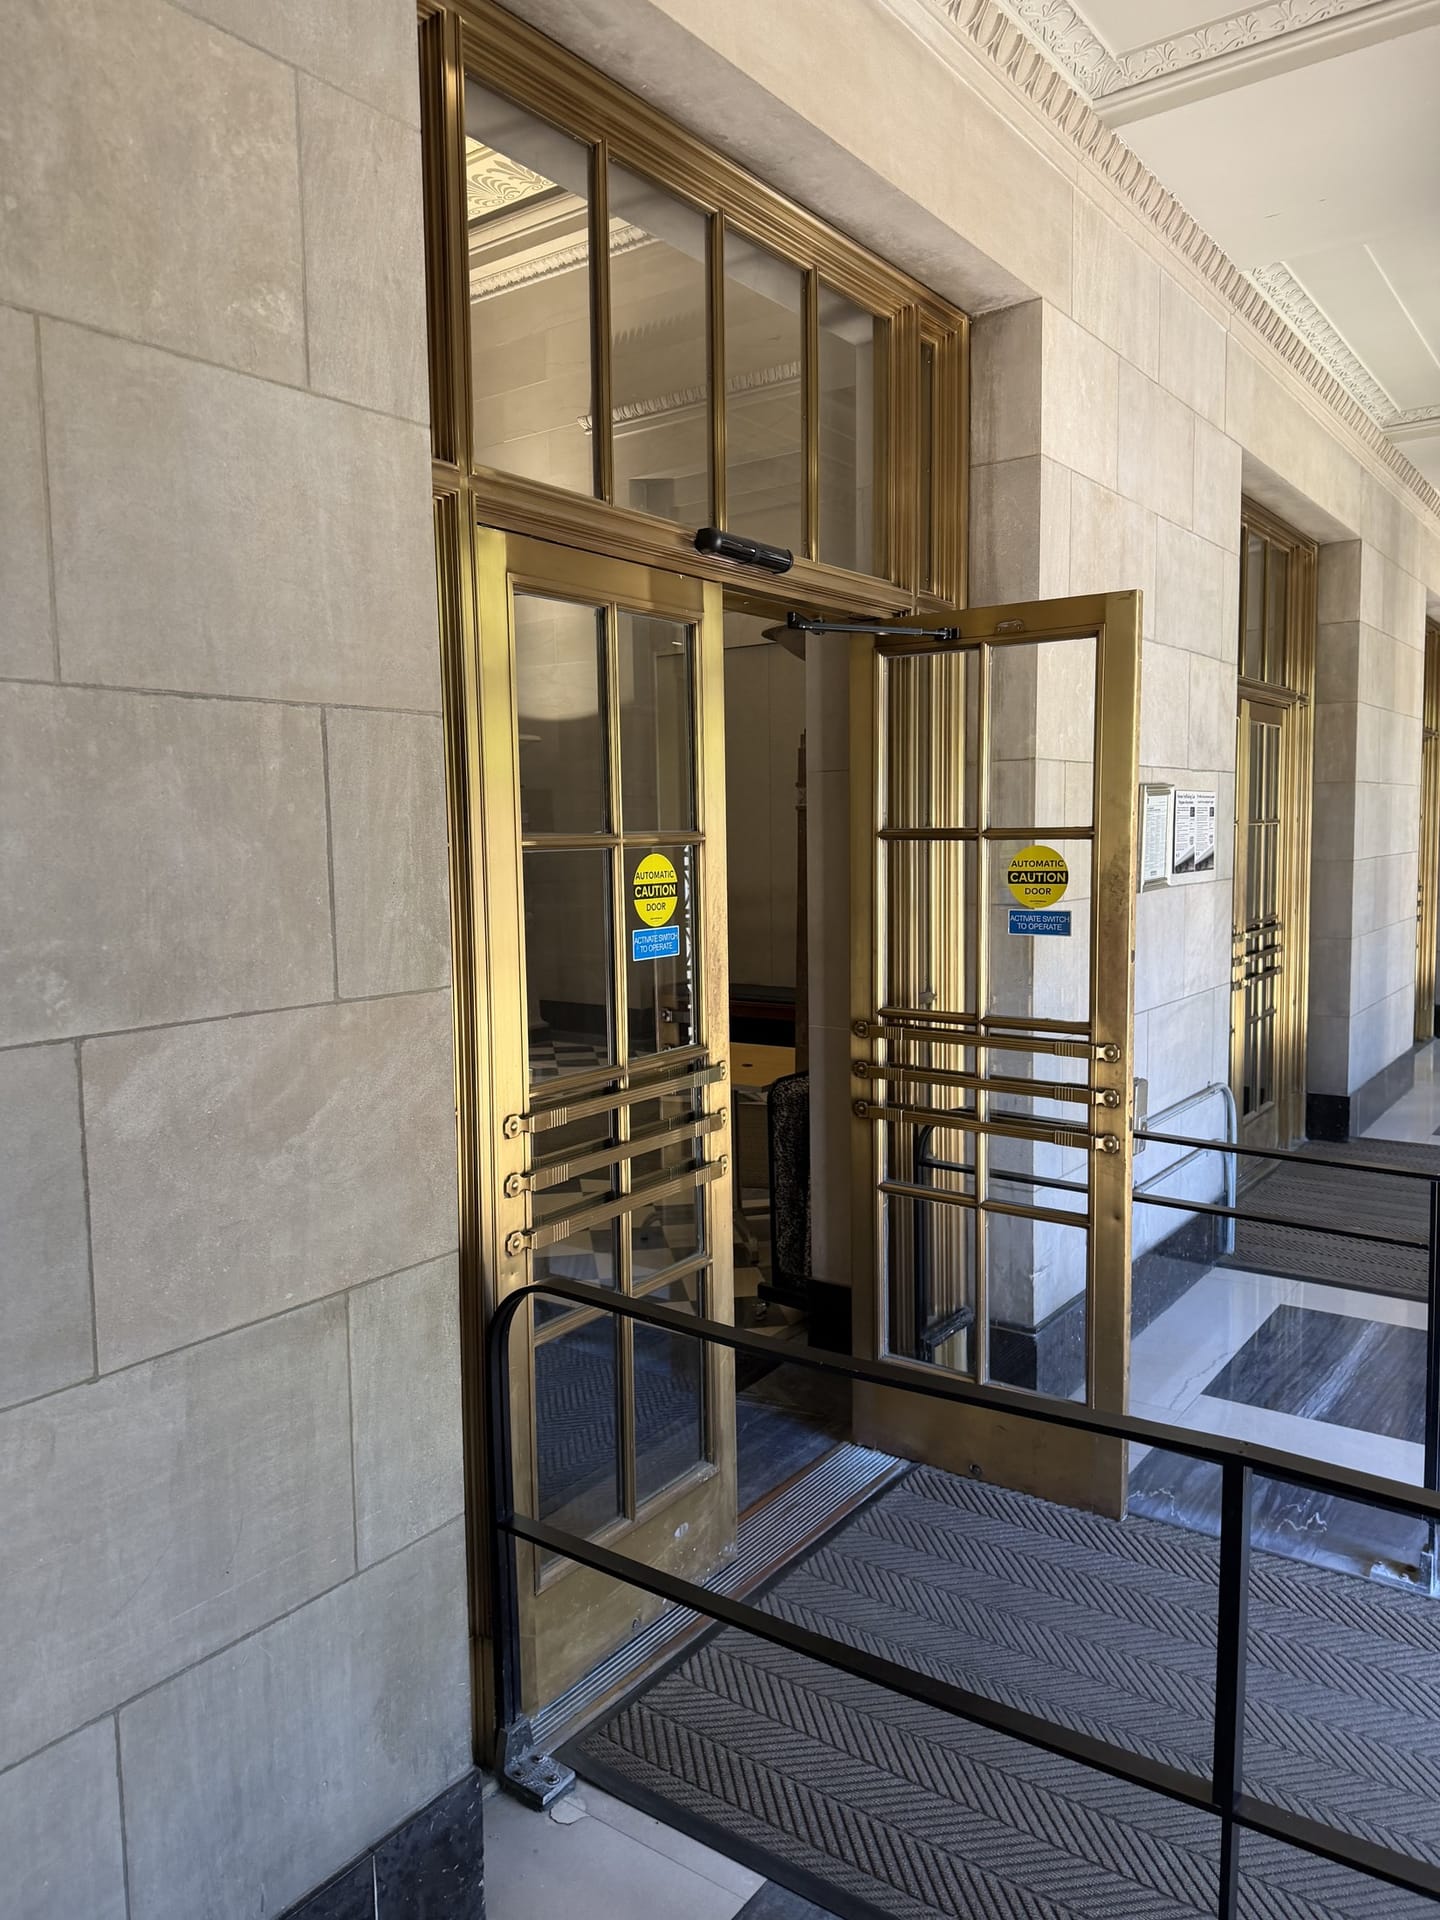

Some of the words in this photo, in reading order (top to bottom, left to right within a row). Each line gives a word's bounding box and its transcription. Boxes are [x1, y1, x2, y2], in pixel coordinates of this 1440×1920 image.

[1011, 860, 1064, 868] AUTOMATIC
[635, 870, 674, 880] AUTOMATIC
[1010, 872, 1066, 883] CAUTION
[634, 884, 676, 898] CAUTION
[1024, 887, 1052, 895] DOOR
[646, 902, 666, 912] DOOR
[1010, 914, 1041, 922] ACTIVATE
[1042, 915, 1070, 923] SWITCH
[1016, 922, 1027, 930] TO
[1028, 922, 1063, 931] OPERATE
[634, 934, 658, 945] ACTIVATE
[658, 932, 678, 942] SWITCH
[640, 944, 648, 953] TO
[648, 942, 673, 952] OPERATE
